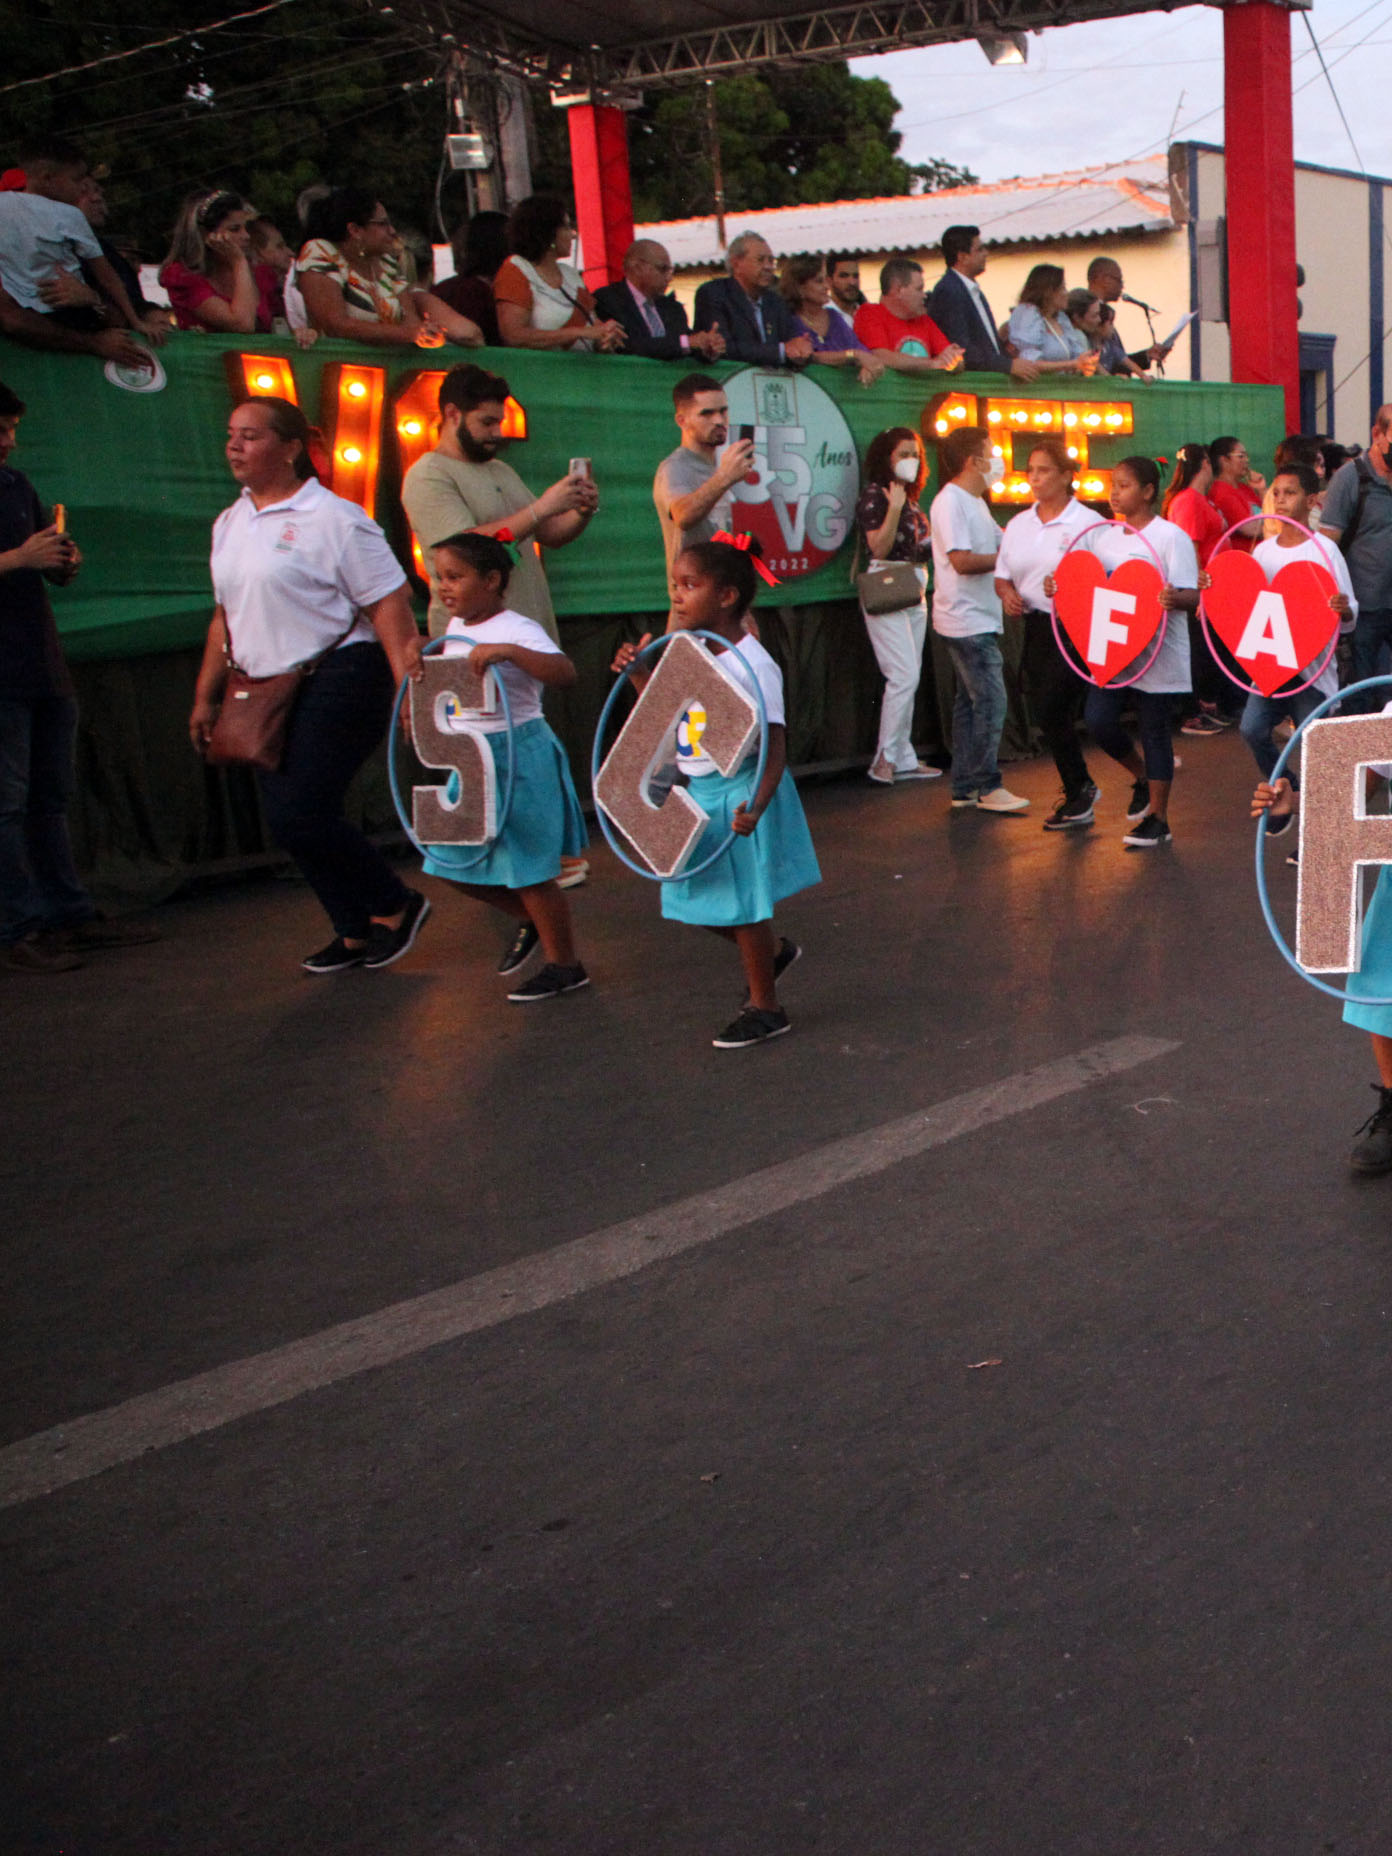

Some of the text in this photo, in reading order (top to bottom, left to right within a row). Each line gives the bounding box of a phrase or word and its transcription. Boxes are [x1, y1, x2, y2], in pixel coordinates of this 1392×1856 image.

[770, 493, 847, 552] VG
[769, 557, 809, 570] 2022
[1088, 587, 1137, 665] F
[1235, 591, 1299, 669] A
[409, 653, 496, 846] S
[594, 633, 758, 877] C
